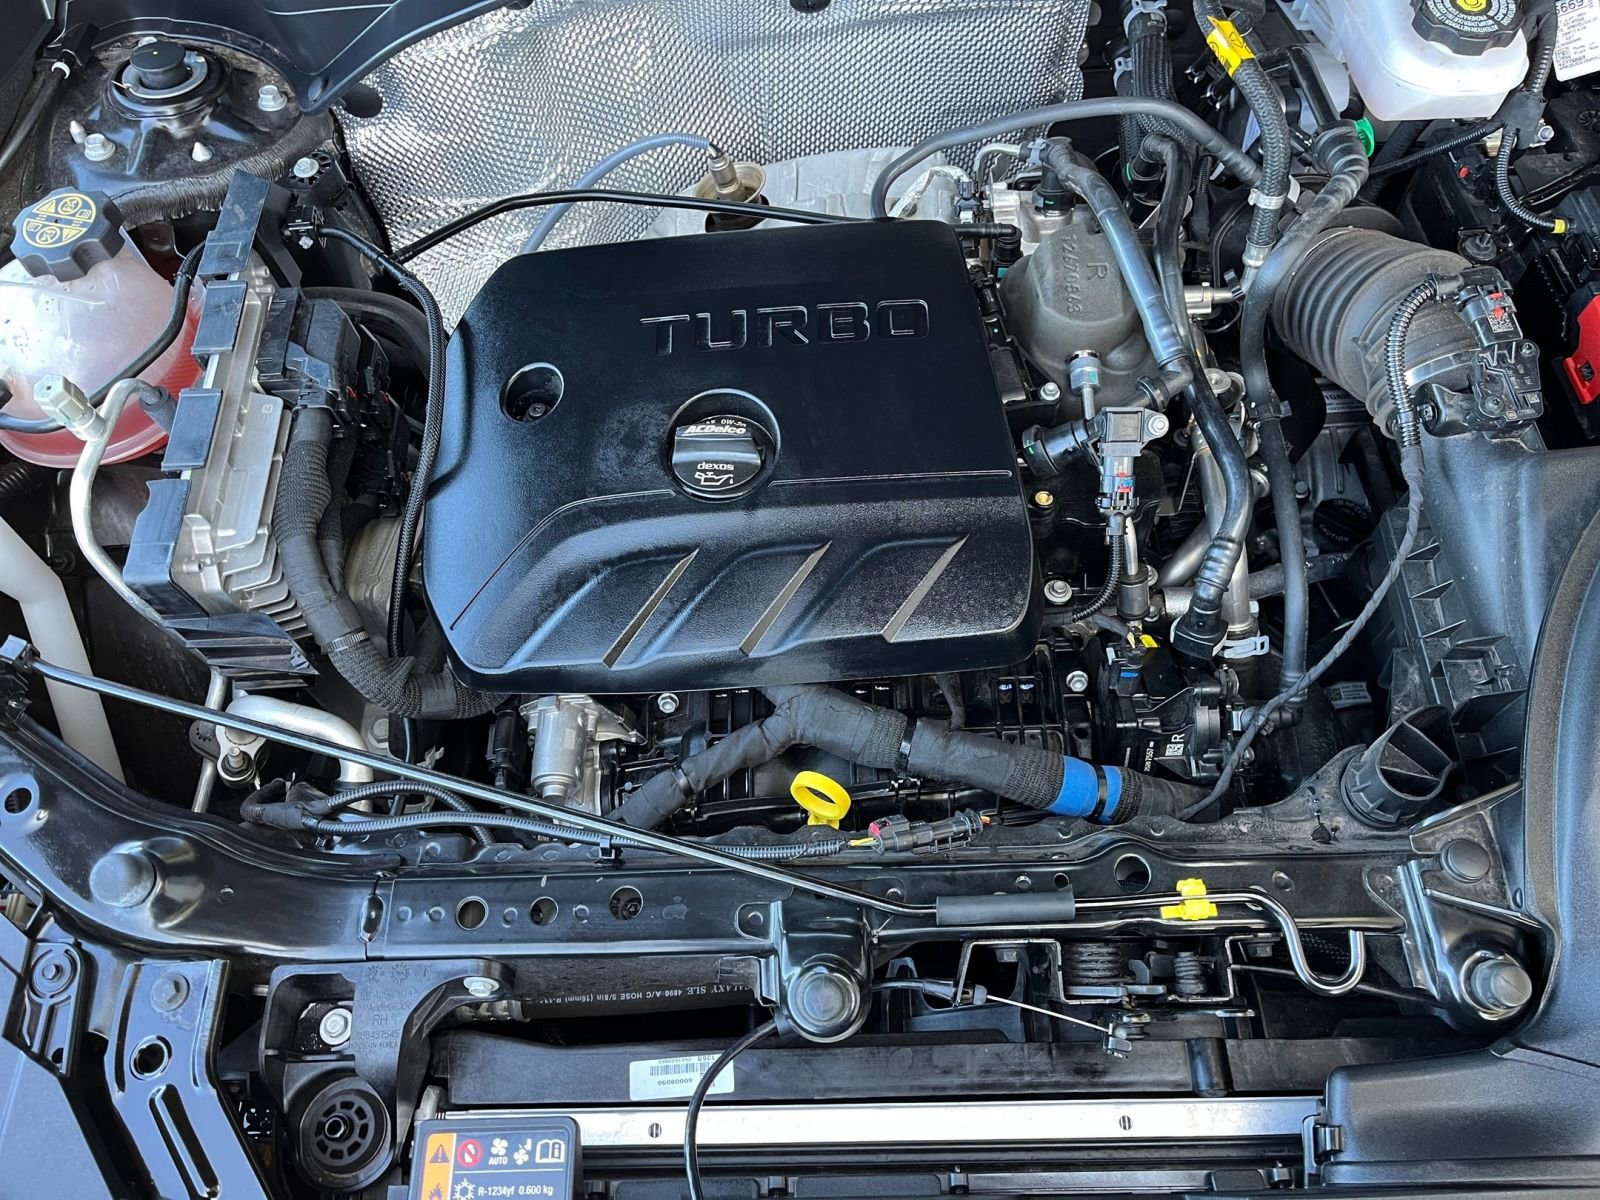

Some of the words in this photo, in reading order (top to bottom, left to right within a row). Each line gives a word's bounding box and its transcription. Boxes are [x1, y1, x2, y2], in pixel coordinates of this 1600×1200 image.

[1087, 262, 1108, 280] R
[640, 299, 930, 356] TURBO
[683, 424, 747, 434] ACDelco
[697, 461, 735, 470] dexos
[1171, 733, 1185, 742] R
[687, 986, 706, 995] SLE
[565, 993, 593, 1004] (16mm)
[597, 993, 616, 1001] 5/8in
[620, 992, 642, 1000] HOSE
[373, 1014, 388, 1026] RH
[488, 1156, 508, 1166] AUTO
[478, 1185, 515, 1198] R-1234yf
[518, 1185, 541, 1195] 0.600
[543, 1184, 554, 1196] kg
